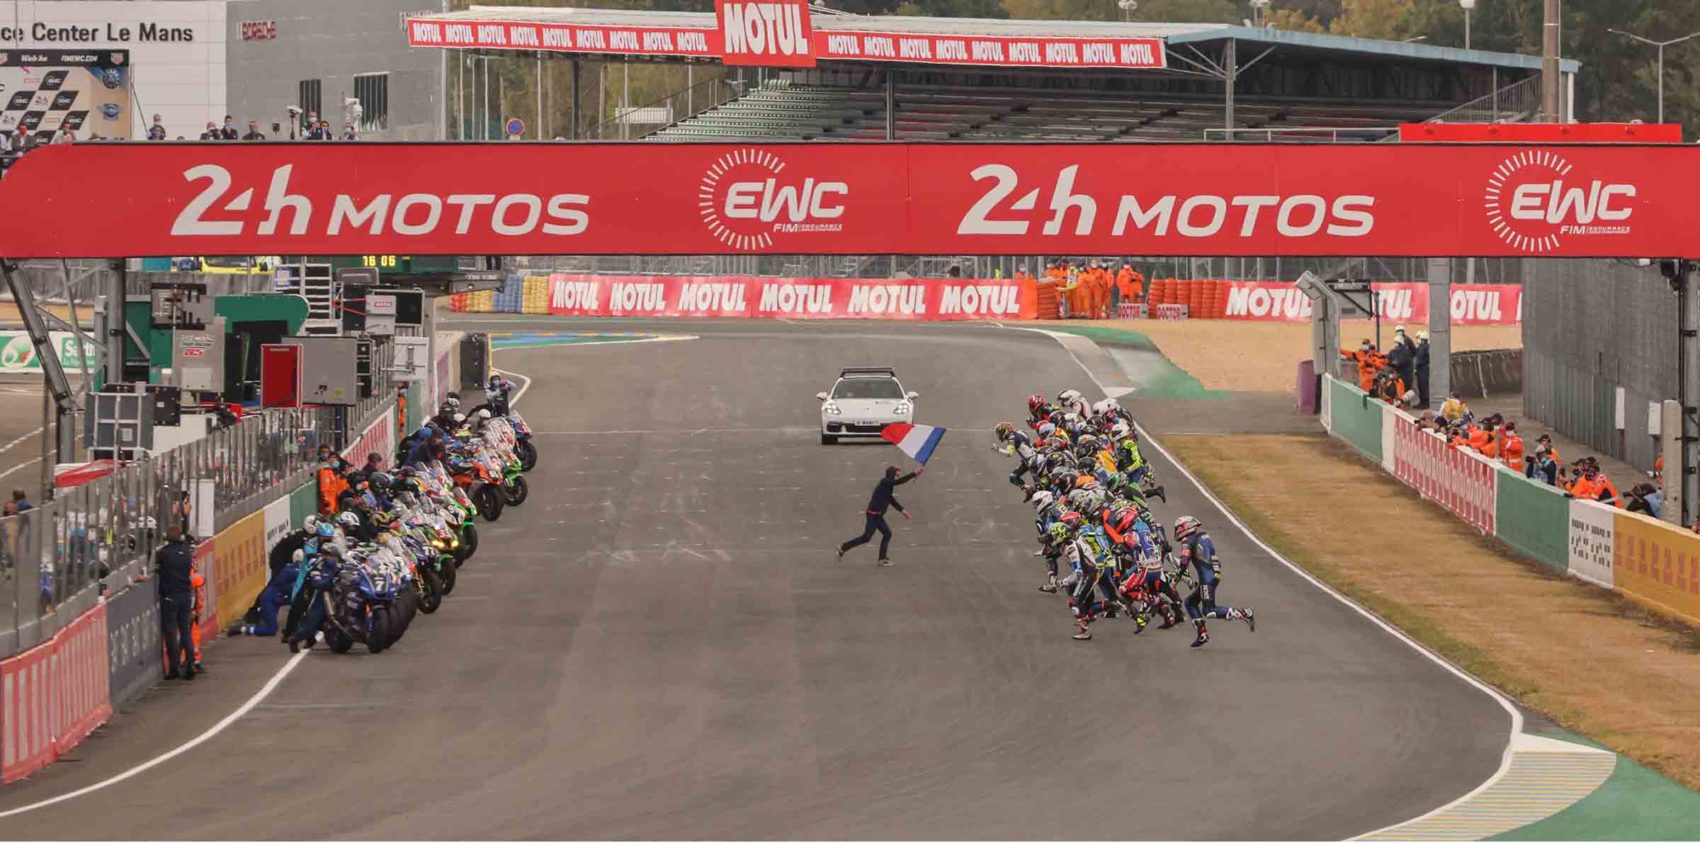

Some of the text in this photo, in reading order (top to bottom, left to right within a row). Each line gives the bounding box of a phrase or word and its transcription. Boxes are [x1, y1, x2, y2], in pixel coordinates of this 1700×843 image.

[32, 22, 99, 42] Center
[107, 22, 130, 42] Le
[139, 22, 193, 42] Mans
[413, 22, 441, 42] MOTUL
[446, 23, 474, 43] MOTUL
[478, 24, 506, 44] MOTUL
[511, 26, 539, 46] MOTUL
[543, 27, 572, 47] MOTUL
[576, 29, 605, 49] MOTUL
[723, 2, 808, 56] MOTUL
[610, 30, 639, 50] MOTUL
[643, 31, 673, 51] MOTUL
[677, 32, 707, 52] MOTUL
[828, 35, 859, 54] MOTUL
[864, 37, 895, 57] MOTUL
[900, 38, 931, 58] MOTUL
[936, 39, 967, 59] MOTUL
[972, 40, 1004, 61] MOTUL
[1009, 41, 1041, 62] MOTUL
[1046, 42, 1078, 63] MOTUL
[1083, 43, 1115, 63] MOTUL
[1121, 44, 1154, 64] MOTUL
[170, 163, 590, 236] 24h MOTOS
[724, 177, 849, 223] EWC
[957, 163, 1375, 237] 24h MOTOS
[1510, 180, 1636, 225] EWC
[773, 223, 798, 233] FIM
[1560, 225, 1586, 235] FIM
[552, 281, 598, 310] MOTUL
[609, 282, 666, 312] MOTUL
[677, 283, 747, 312] MOTUL
[759, 283, 834, 313] MOTUL
[847, 285, 926, 314] MOTUL
[939, 285, 1020, 314] MOTUL
[1372, 289, 1412, 318] TUL
[1450, 290, 1502, 321] OTUL
[375, 580, 385, 592] 7
